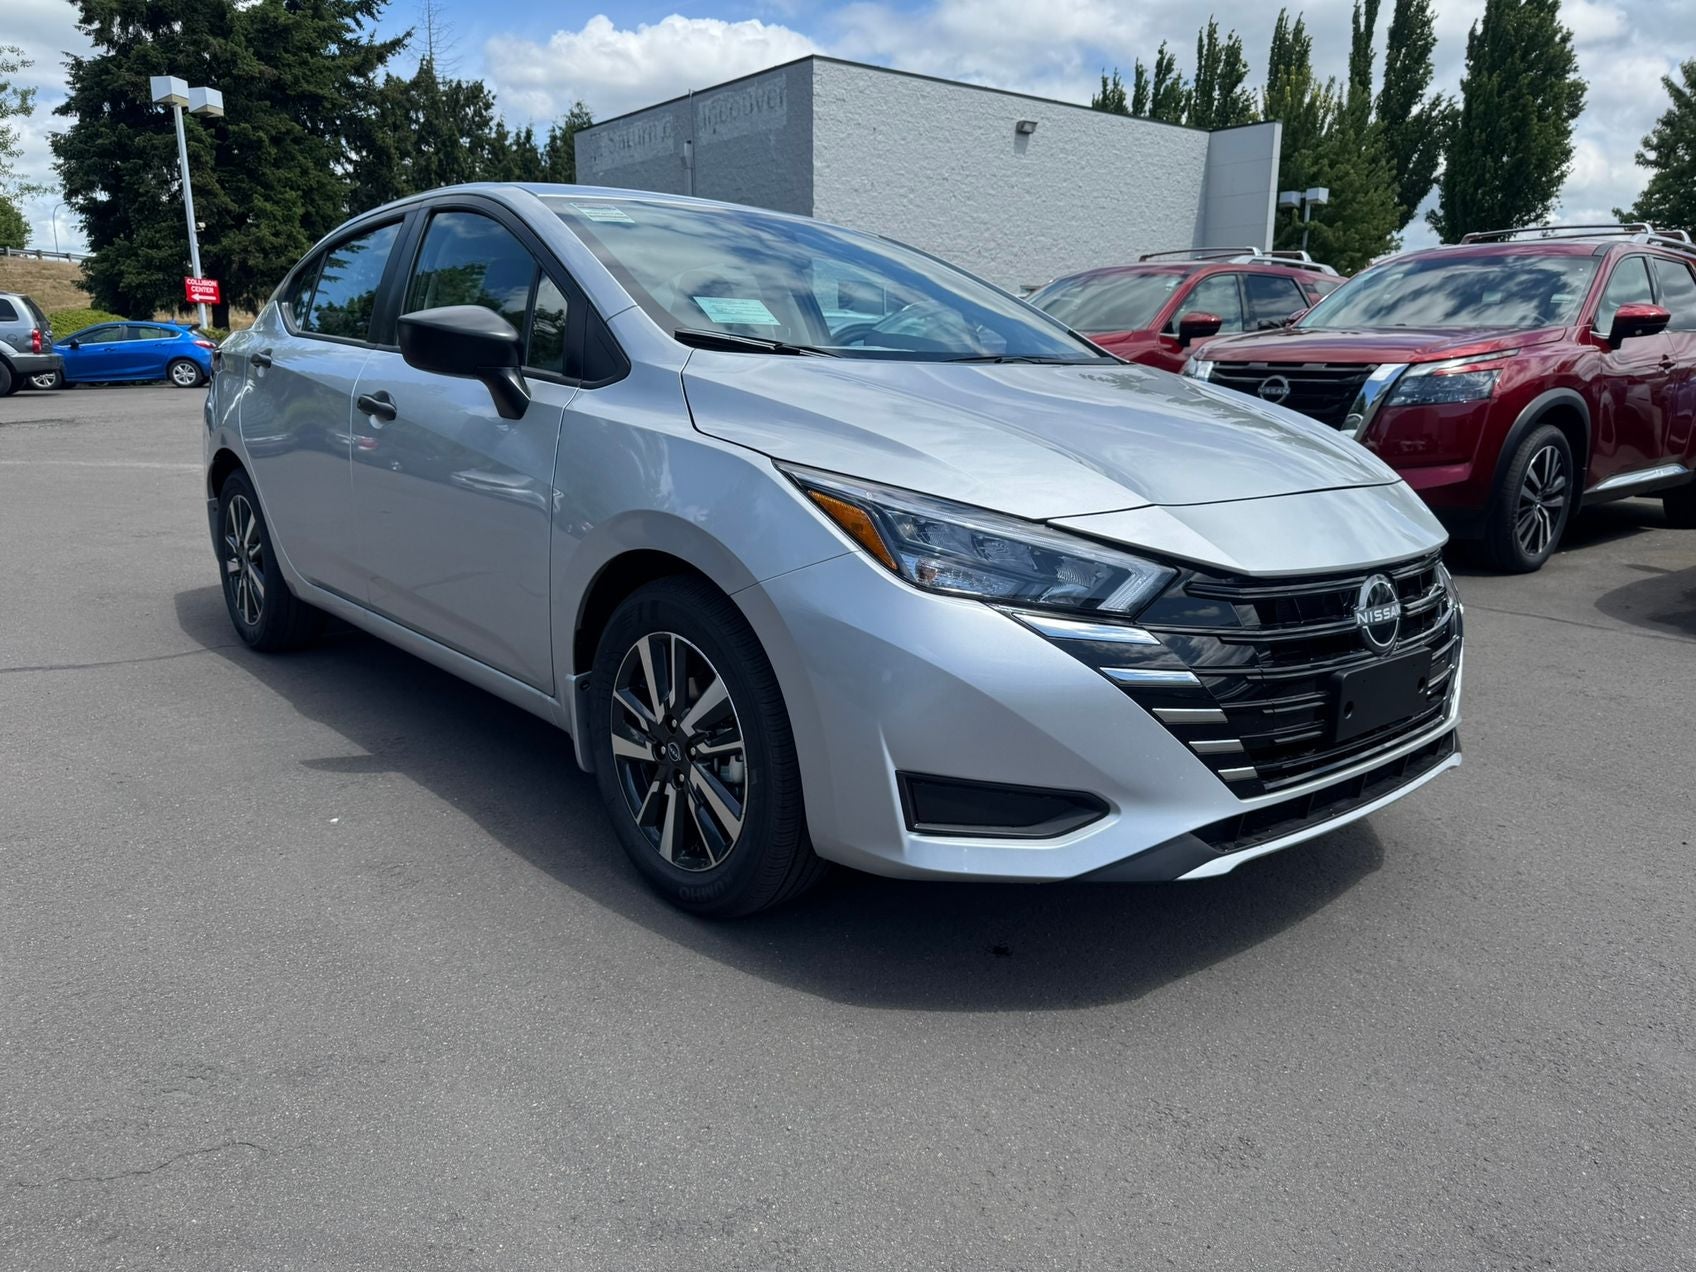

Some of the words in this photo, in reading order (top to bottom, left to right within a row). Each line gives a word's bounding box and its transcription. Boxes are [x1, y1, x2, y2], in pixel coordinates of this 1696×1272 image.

[186, 278, 217, 287] COLLISION
[190, 285, 214, 294] CENTER
[1356, 603, 1401, 624] NISSAN
